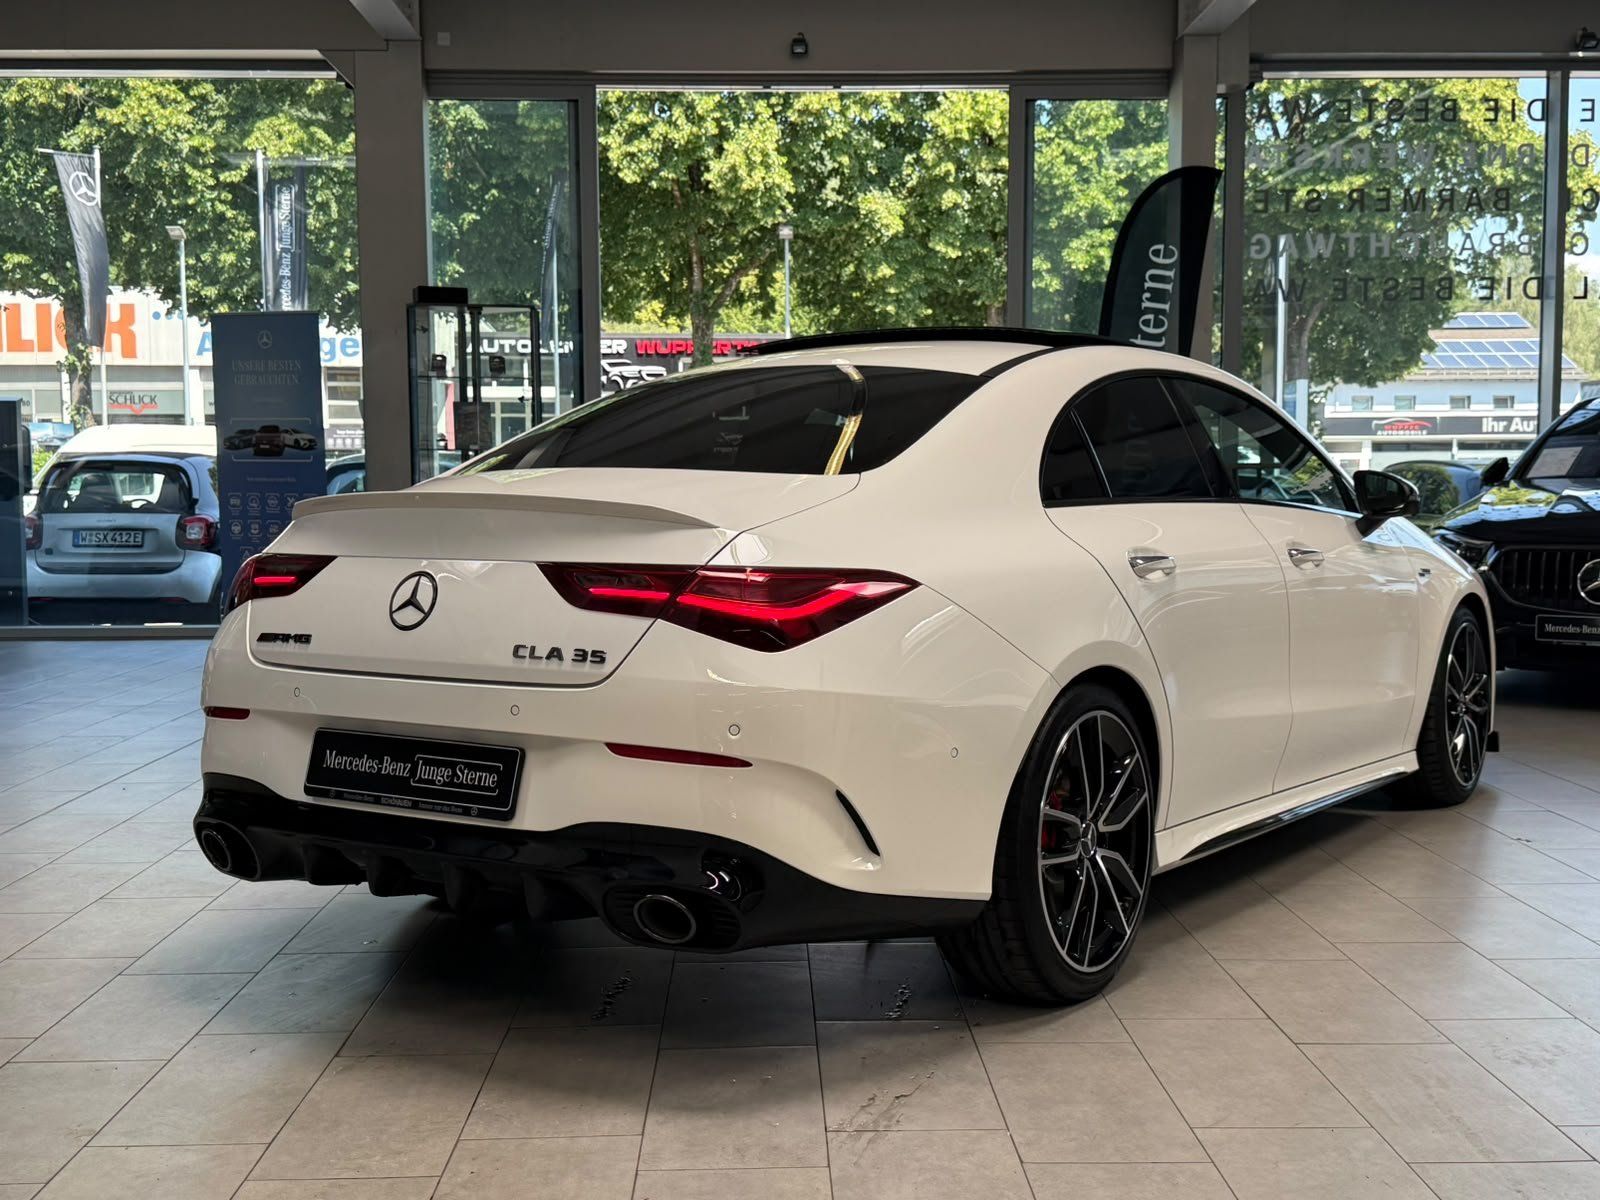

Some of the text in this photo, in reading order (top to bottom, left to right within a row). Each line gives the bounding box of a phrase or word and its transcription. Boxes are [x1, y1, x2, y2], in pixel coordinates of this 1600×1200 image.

[109, 394, 158, 405] SCHLICK
[1481, 417, 1507, 433] Ihr
[94, 531, 109, 544] SX
[111, 531, 140, 544] 412E
[512, 644, 607, 664] CLA 35
[323, 749, 498, 788] Mercedes-Benz Junge Sterne
